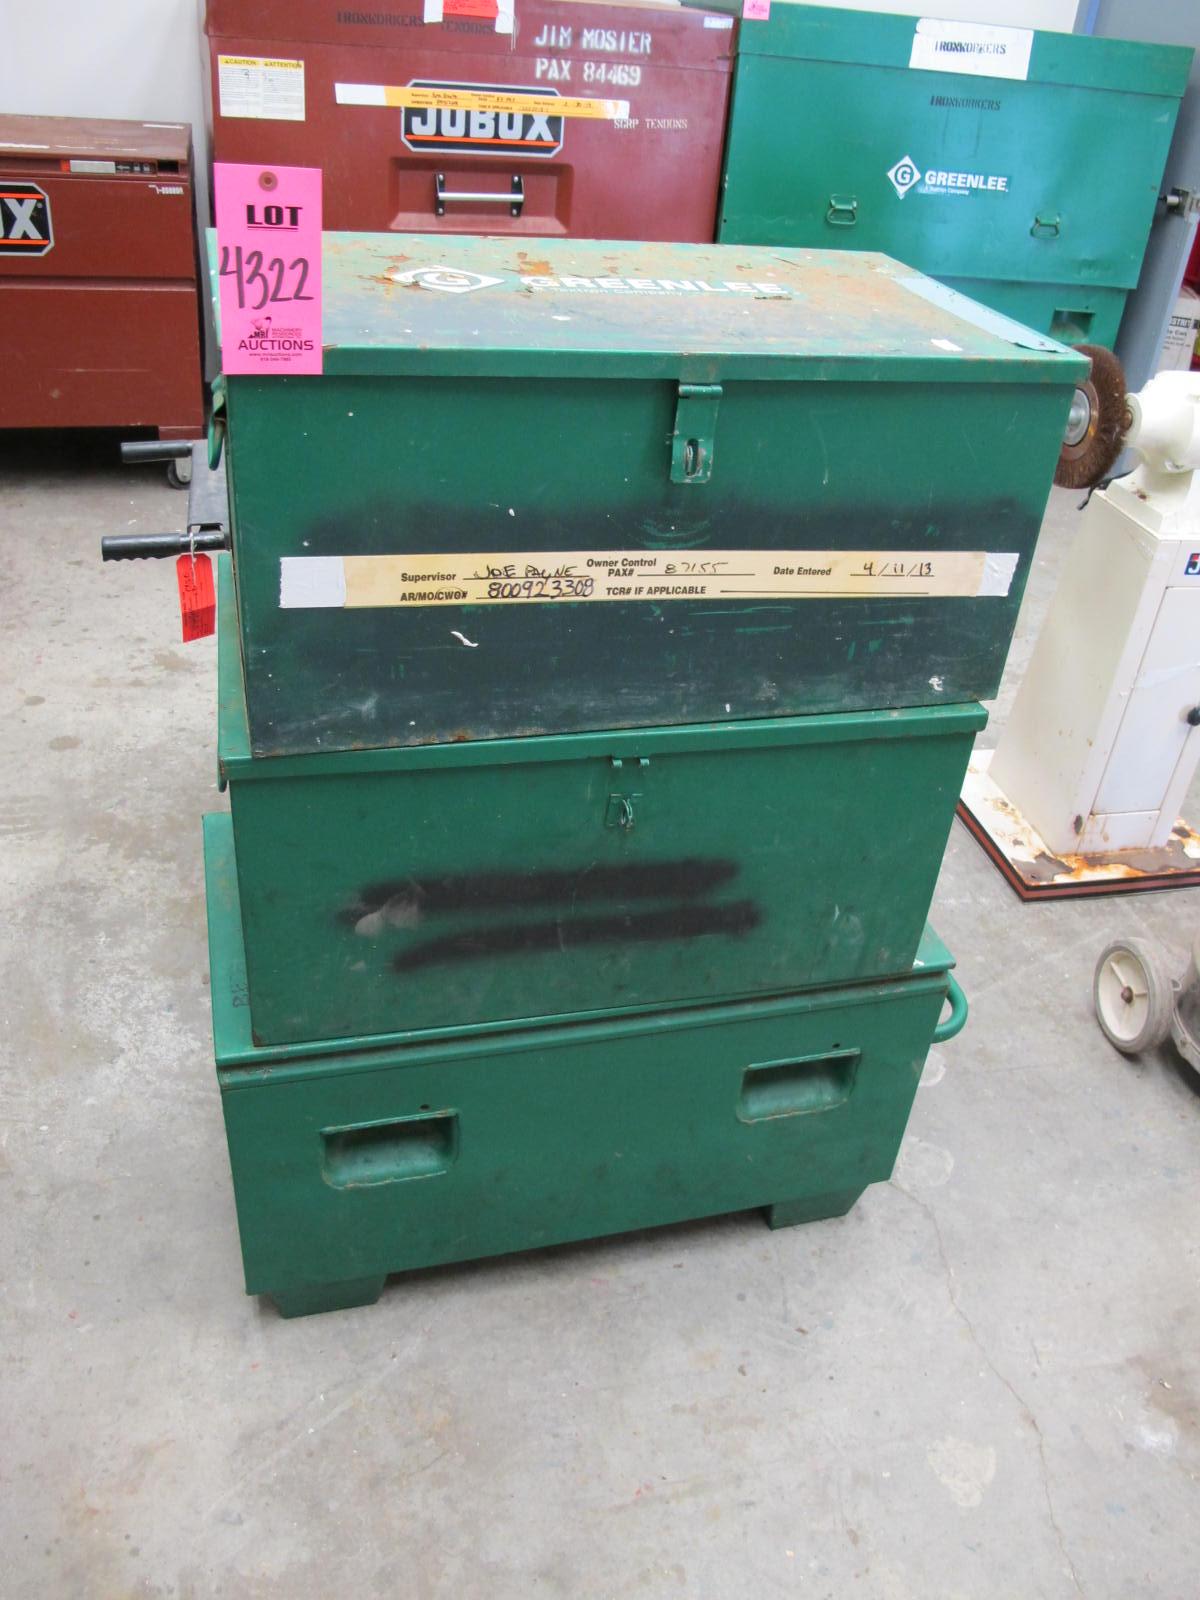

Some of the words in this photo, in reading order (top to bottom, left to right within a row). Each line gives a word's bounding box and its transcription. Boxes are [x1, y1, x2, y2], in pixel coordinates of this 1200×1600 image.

[535, 25, 572, 47] JIM
[582, 28, 652, 53] MOSIER
[536, 58, 571, 81] PAX
[583, 62, 641, 86] 84469
[645, 119, 689, 129] TENDONS
[925, 170, 1008, 192] GREENLEE
[0, 198, 43, 239] X
[246, 205, 303, 226] LOT
[219, 246, 314, 310] 4322
[520, 276, 789, 294] GREENLEE
[238, 340, 314, 351] AUCTIONS
[586, 558, 618, 567] Owner
[621, 558, 657, 567] Control
[608, 568, 635, 577] PAX#
[664, 561, 728, 574] 87155
[773, 566, 794, 576] Date
[797, 566, 832, 576] Entered
[401, 572, 456, 583] Supervisor
[474, 564, 515, 580] JOE
[606, 586, 631, 596] TCR#
[635, 587, 643, 595] IF
[646, 586, 706, 595] APPLICABLE
